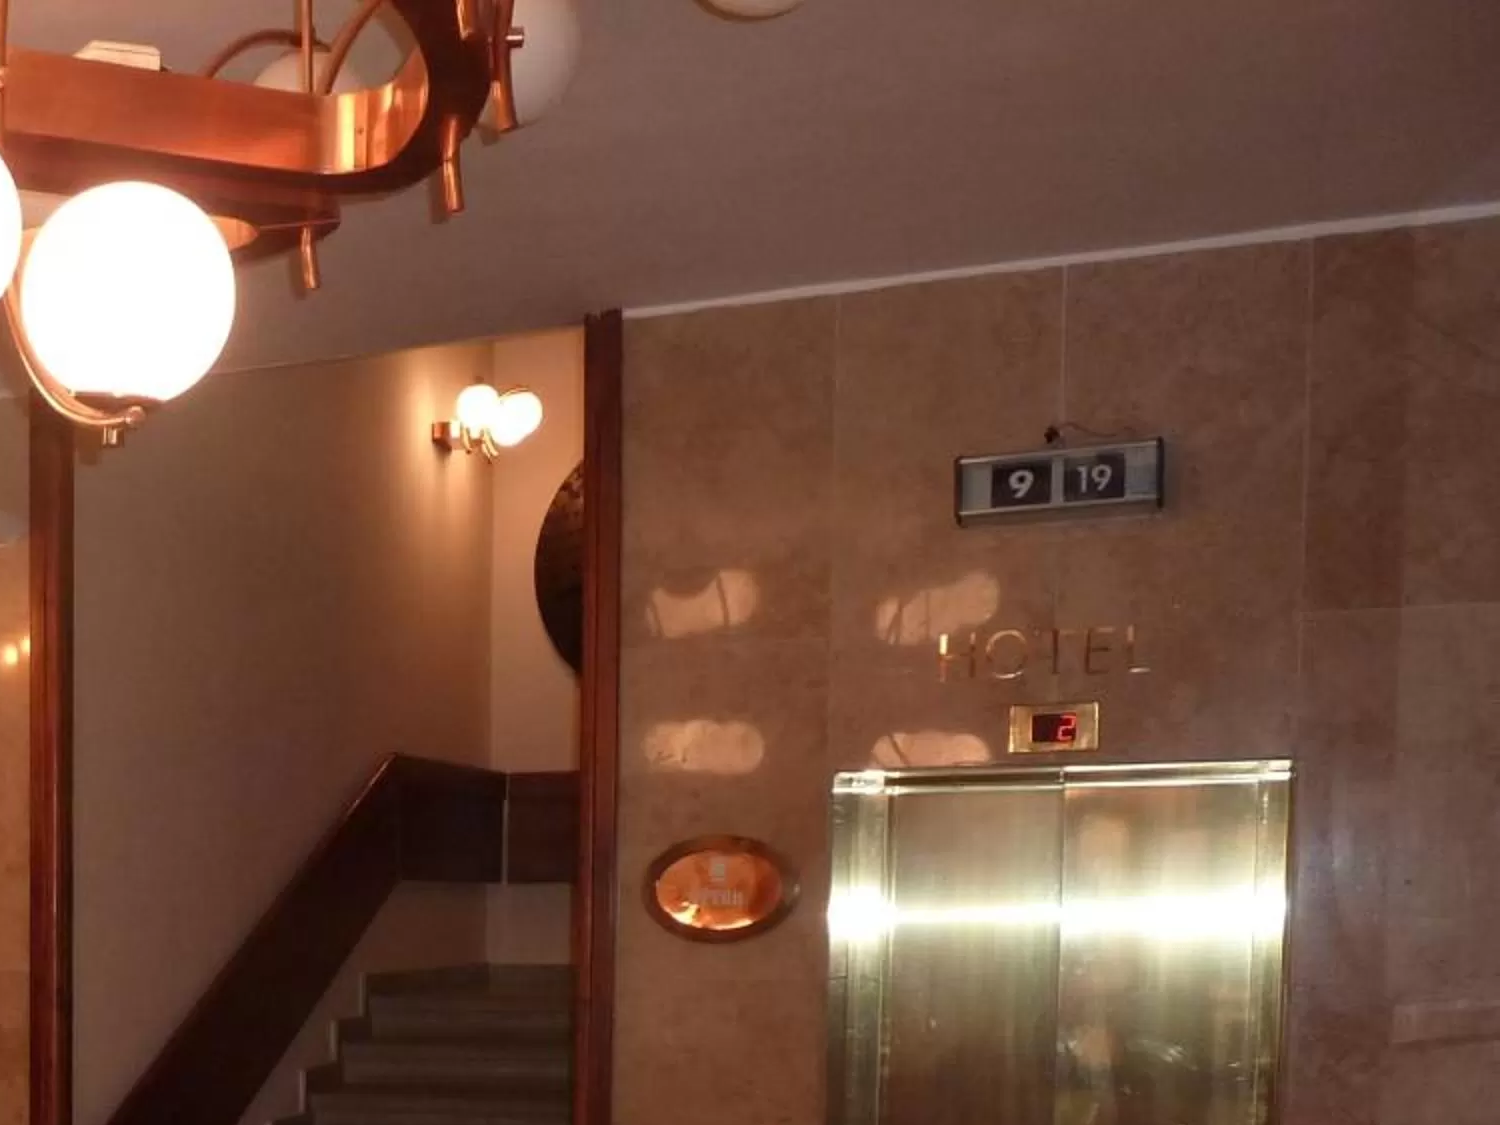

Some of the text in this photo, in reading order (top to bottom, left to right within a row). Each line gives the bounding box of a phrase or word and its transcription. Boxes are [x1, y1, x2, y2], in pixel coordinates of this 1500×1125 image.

[1008, 464, 1112, 499] 9 19
[938, 624, 1151, 682] HOTEL
[1056, 714, 1077, 742] 2
